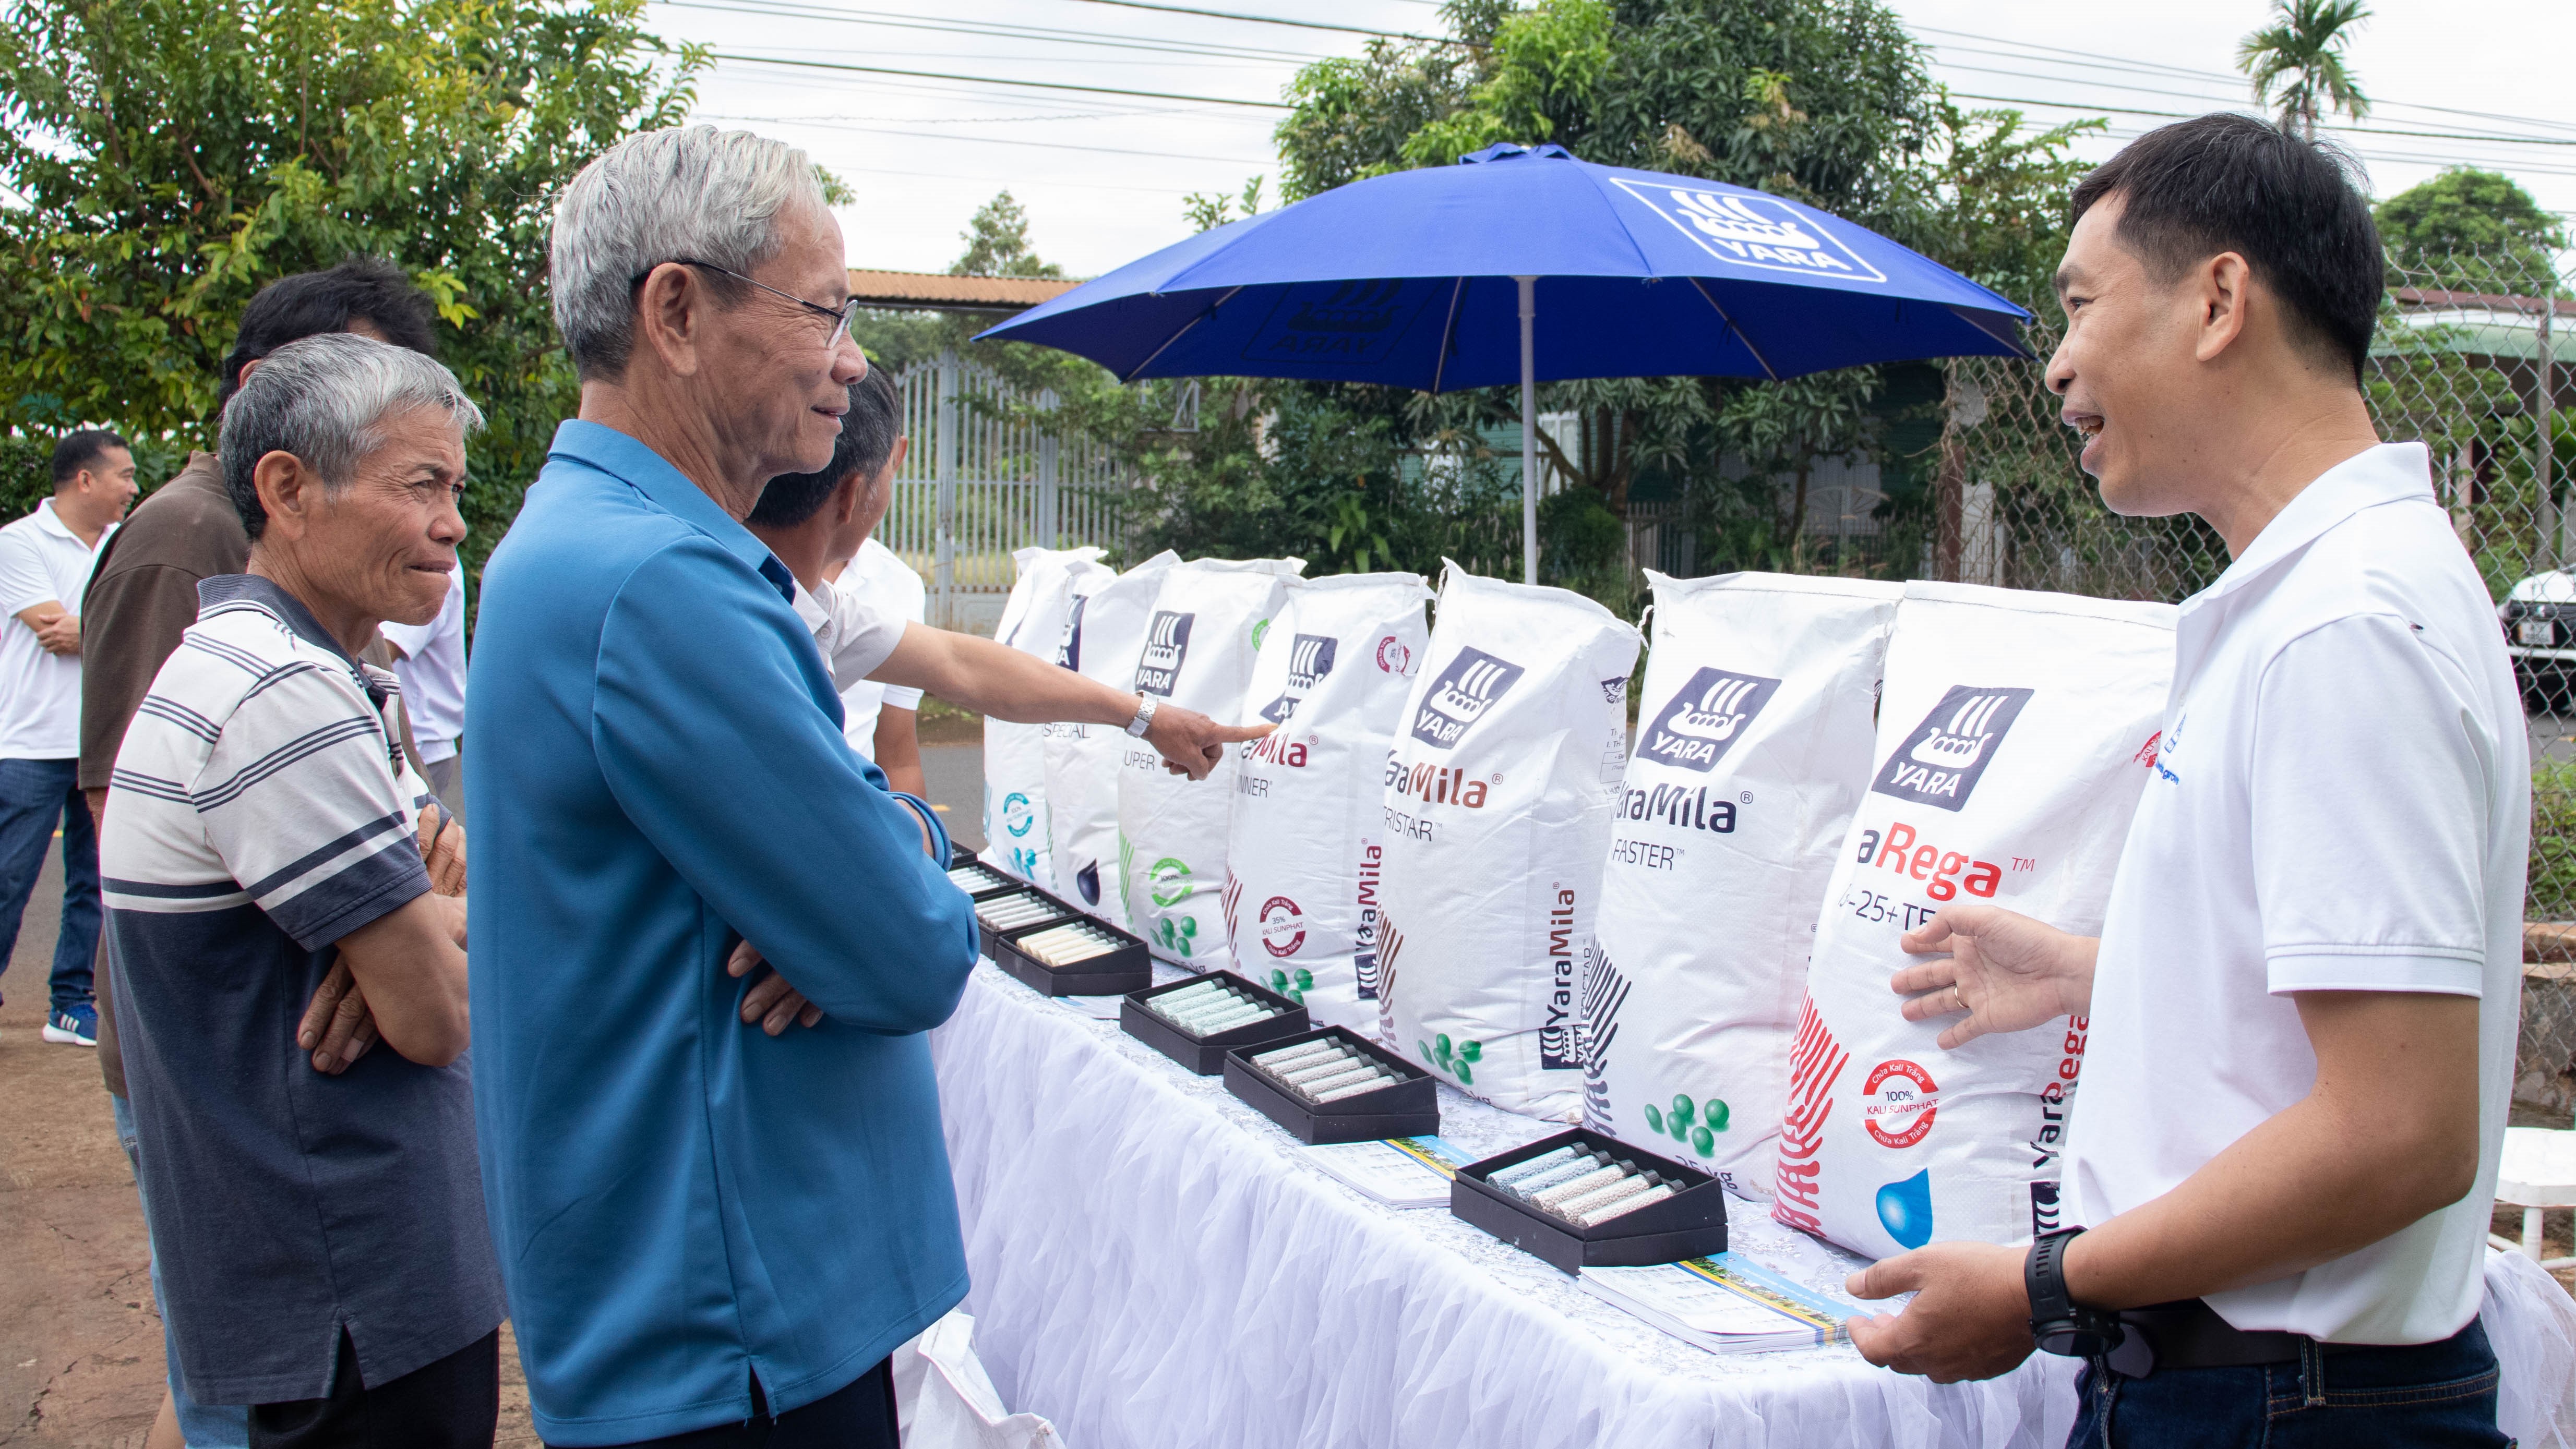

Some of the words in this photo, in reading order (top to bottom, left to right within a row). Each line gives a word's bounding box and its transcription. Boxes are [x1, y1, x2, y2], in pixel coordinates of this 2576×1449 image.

[1712, 238, 1853, 271] YARA
[1136, 669, 1171, 689] YARA
[1043, 723, 1091, 738] SPECIAL
[1416, 709, 1464, 741] YARA
[1650, 731, 1716, 764] YARA
[1124, 750, 1155, 771] UPER
[1890, 762, 1961, 798] YARA
[1274, 922, 1304, 933] SUNPHAT
[1885, 1091, 1914, 1101] 100%
[1867, 1105, 1887, 1115] KALI
[1889, 1098, 1939, 1114] SUNPHAT
[1894, 1136, 1908, 1145] Kali
